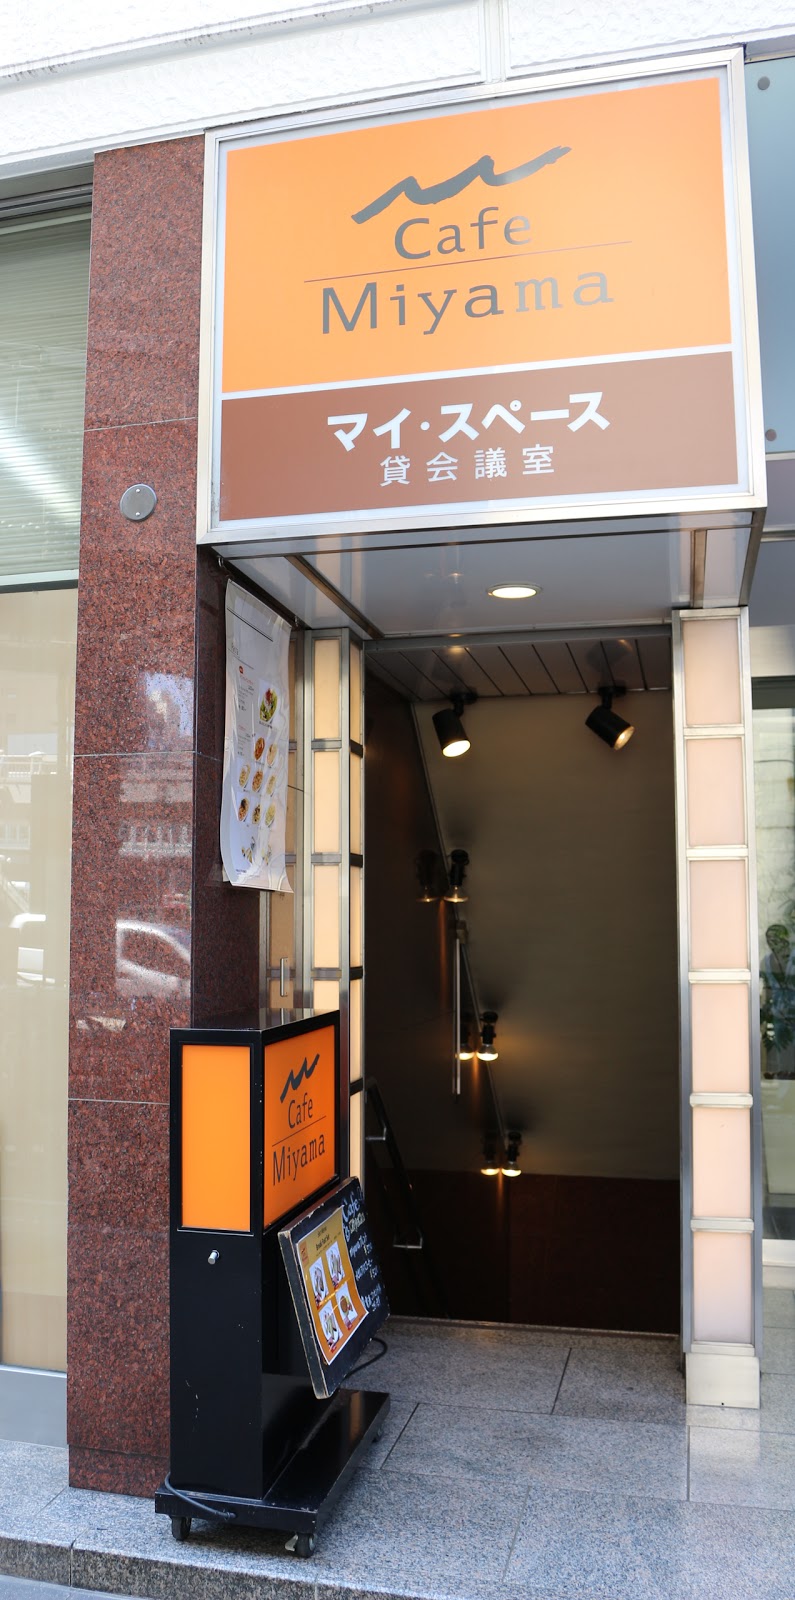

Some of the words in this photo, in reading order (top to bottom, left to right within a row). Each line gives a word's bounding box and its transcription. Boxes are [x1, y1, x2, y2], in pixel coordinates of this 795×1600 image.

[394, 206, 532, 260] Cafe
[322, 270, 614, 335] Miyama
[327, 391, 610, 452] マイ・スペース
[380, 443, 554, 487] 貸会議室
[288, 1092, 314, 1129] Cafe
[273, 1134, 326, 1186] Miyama
